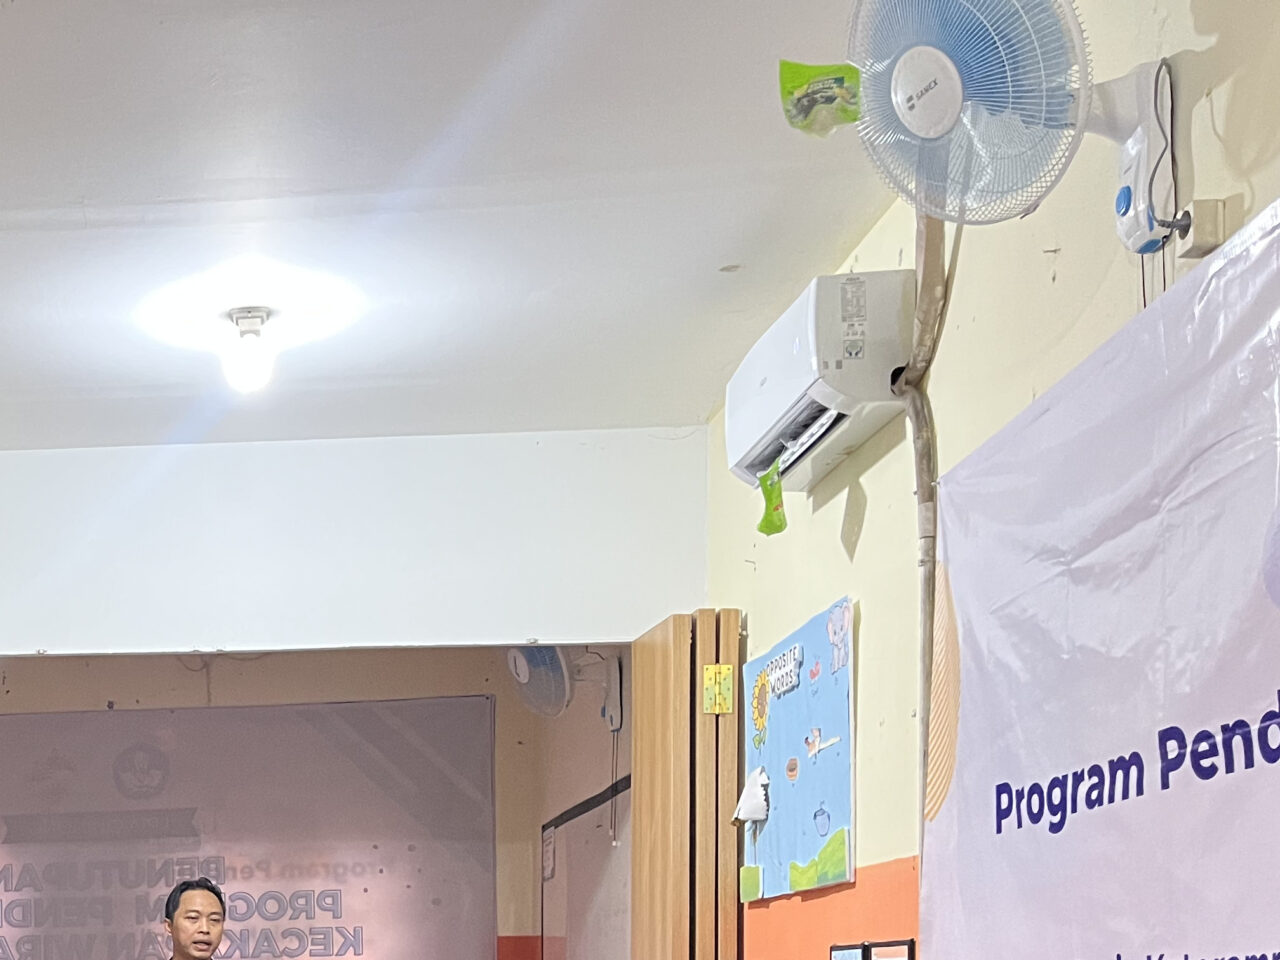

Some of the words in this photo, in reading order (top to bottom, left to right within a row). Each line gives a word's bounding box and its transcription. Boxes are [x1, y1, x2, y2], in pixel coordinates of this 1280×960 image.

[766, 646, 797, 677] OPPOSITE
[770, 669, 793, 694] WORDS
[995, 751, 1145, 834] Program
